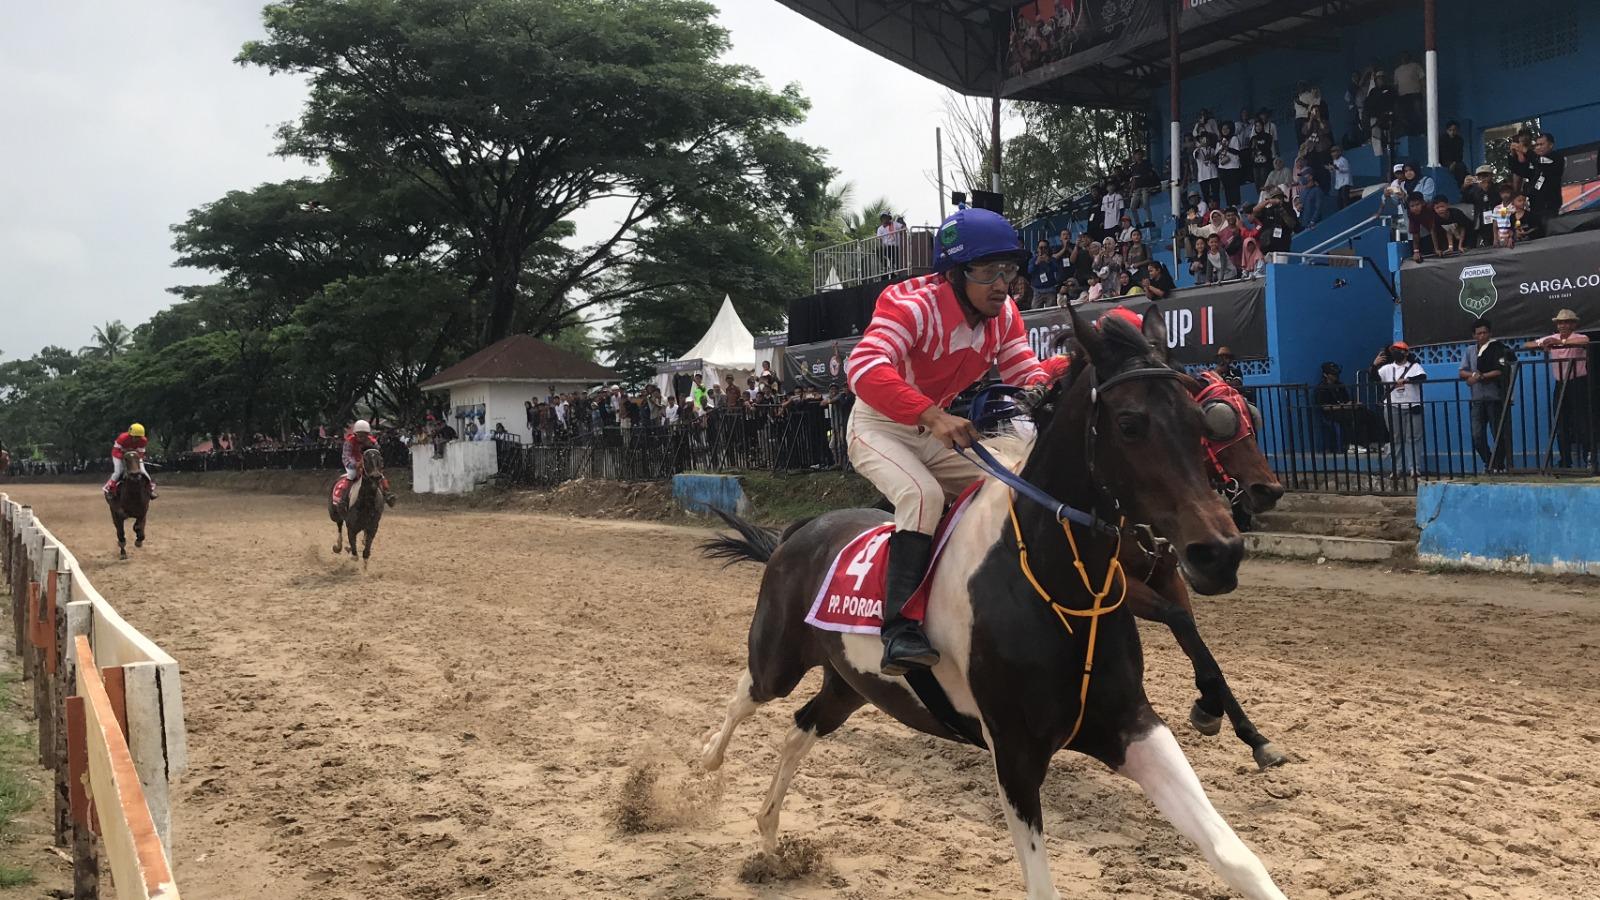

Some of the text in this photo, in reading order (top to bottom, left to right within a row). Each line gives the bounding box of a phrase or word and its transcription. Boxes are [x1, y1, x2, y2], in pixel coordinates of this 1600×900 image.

[1519, 274, 1600, 295] SARGA.CO
[1164, 308, 1193, 348] UP
[845, 532, 892, 592] 4
[827, 594, 884, 620] PP. PORDA
